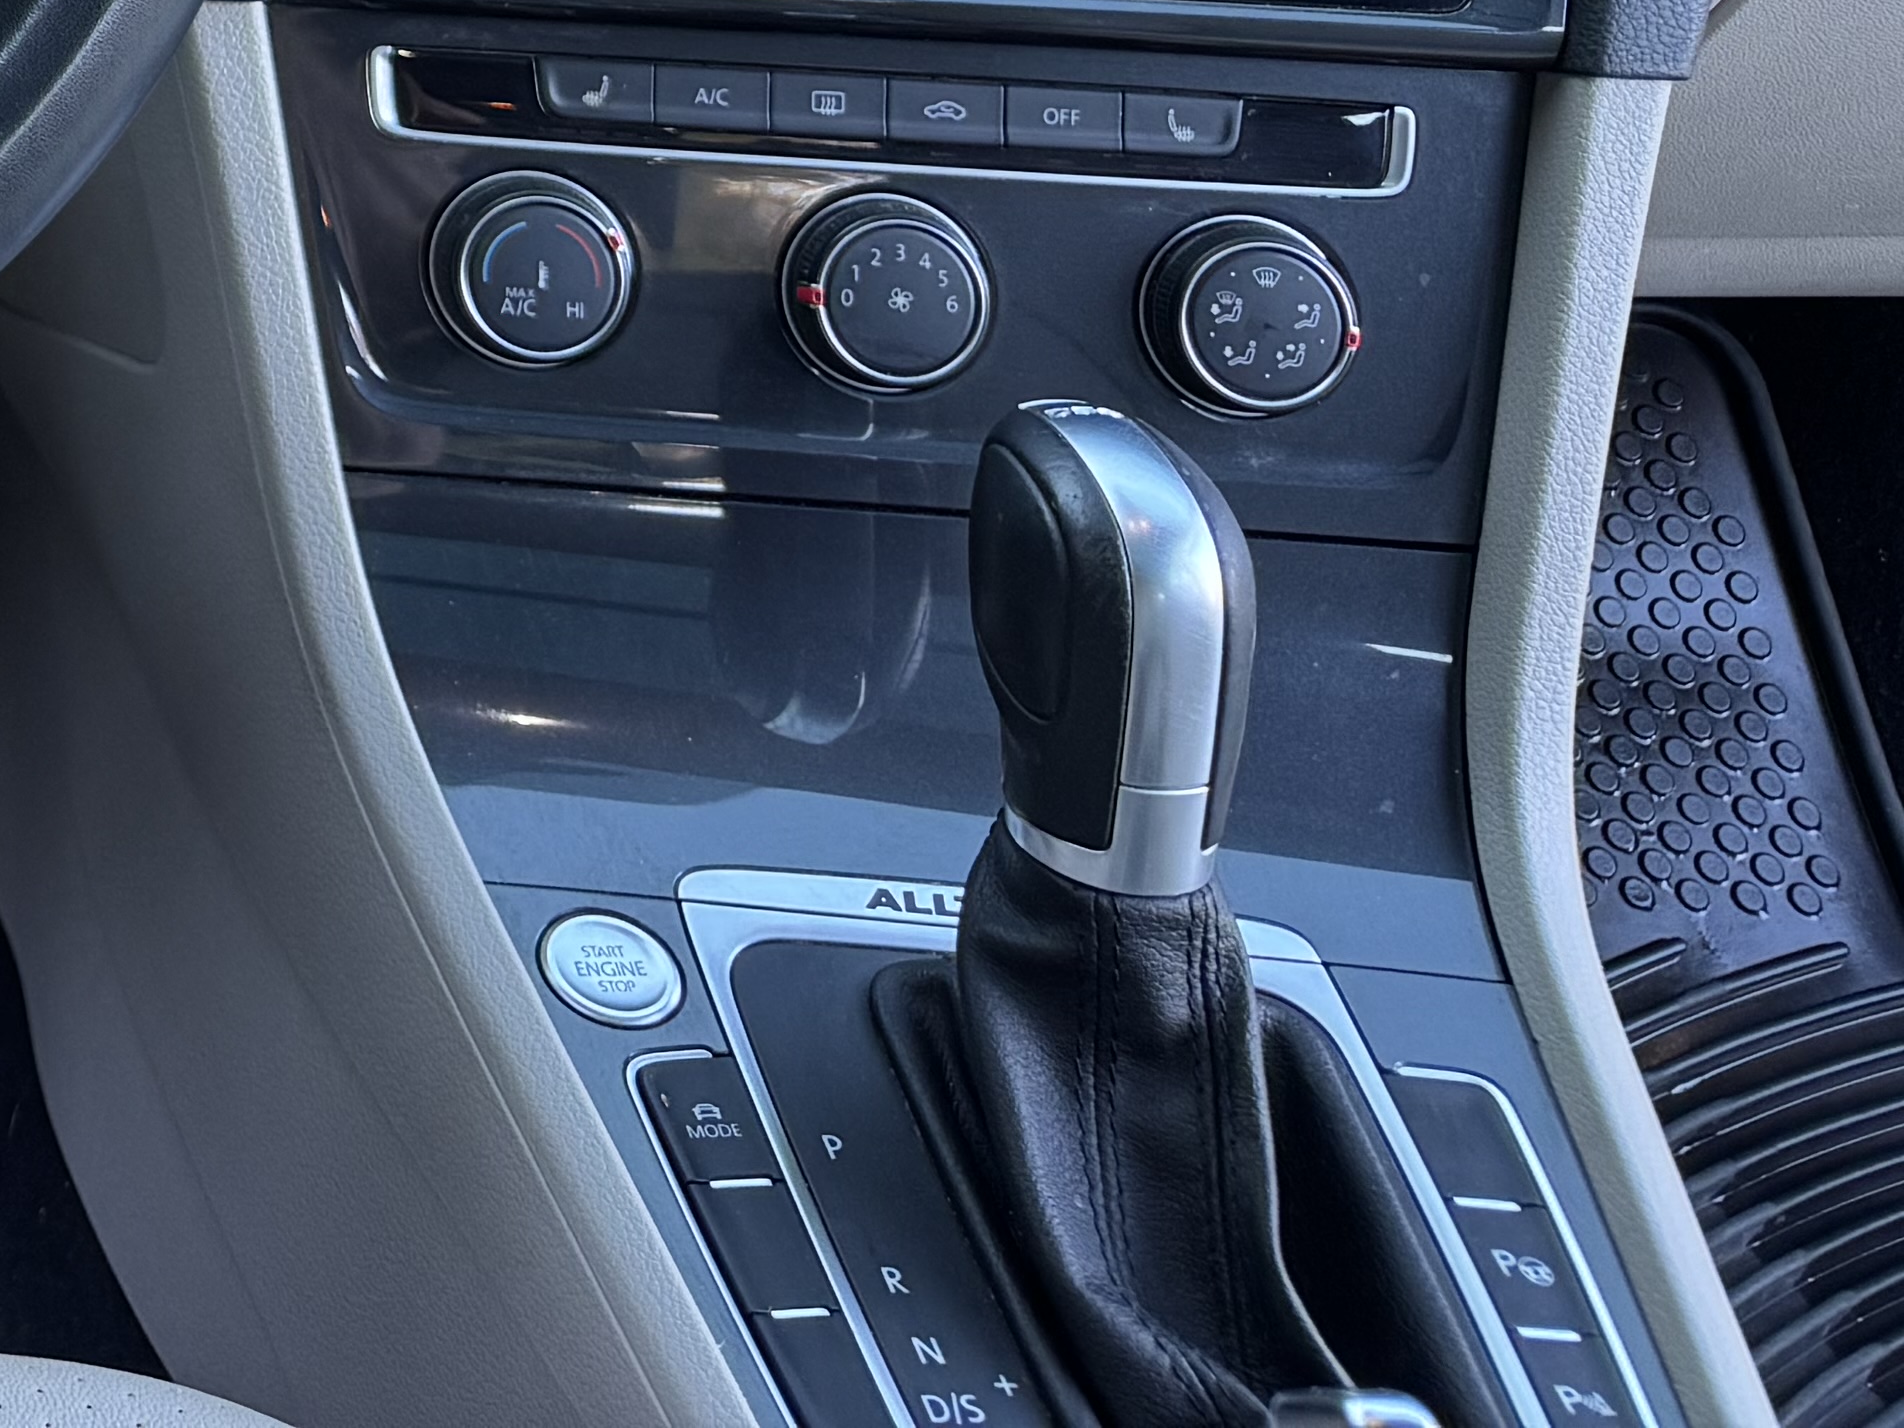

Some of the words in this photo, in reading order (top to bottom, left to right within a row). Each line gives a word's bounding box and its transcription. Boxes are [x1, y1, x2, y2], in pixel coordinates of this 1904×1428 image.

[694, 88, 730, 107] A/C
[1043, 108, 1080, 127] OFF
[871, 248, 882, 266] 2
[896, 243, 906, 262] 3
[919, 252, 932, 270] 4
[852, 264, 859, 282] 1
[938, 270, 949, 287] 5
[505, 286, 535, 298] MAX
[840, 288, 854, 307] 0
[500, 297, 537, 317] A/C
[566, 301, 585, 319] HI
[946, 295, 959, 313] 6
[865, 888, 964, 917] ALL
[581, 945, 624, 958] START
[574, 960, 648, 977] ENGINE
[598, 980, 636, 992] STOP
[686, 1122, 742, 1139] MODE
[822, 1134, 842, 1160] P
[881, 1266, 910, 1295] R
[911, 1336, 946, 1365] N
[920, 1392, 986, 1425] D/S
